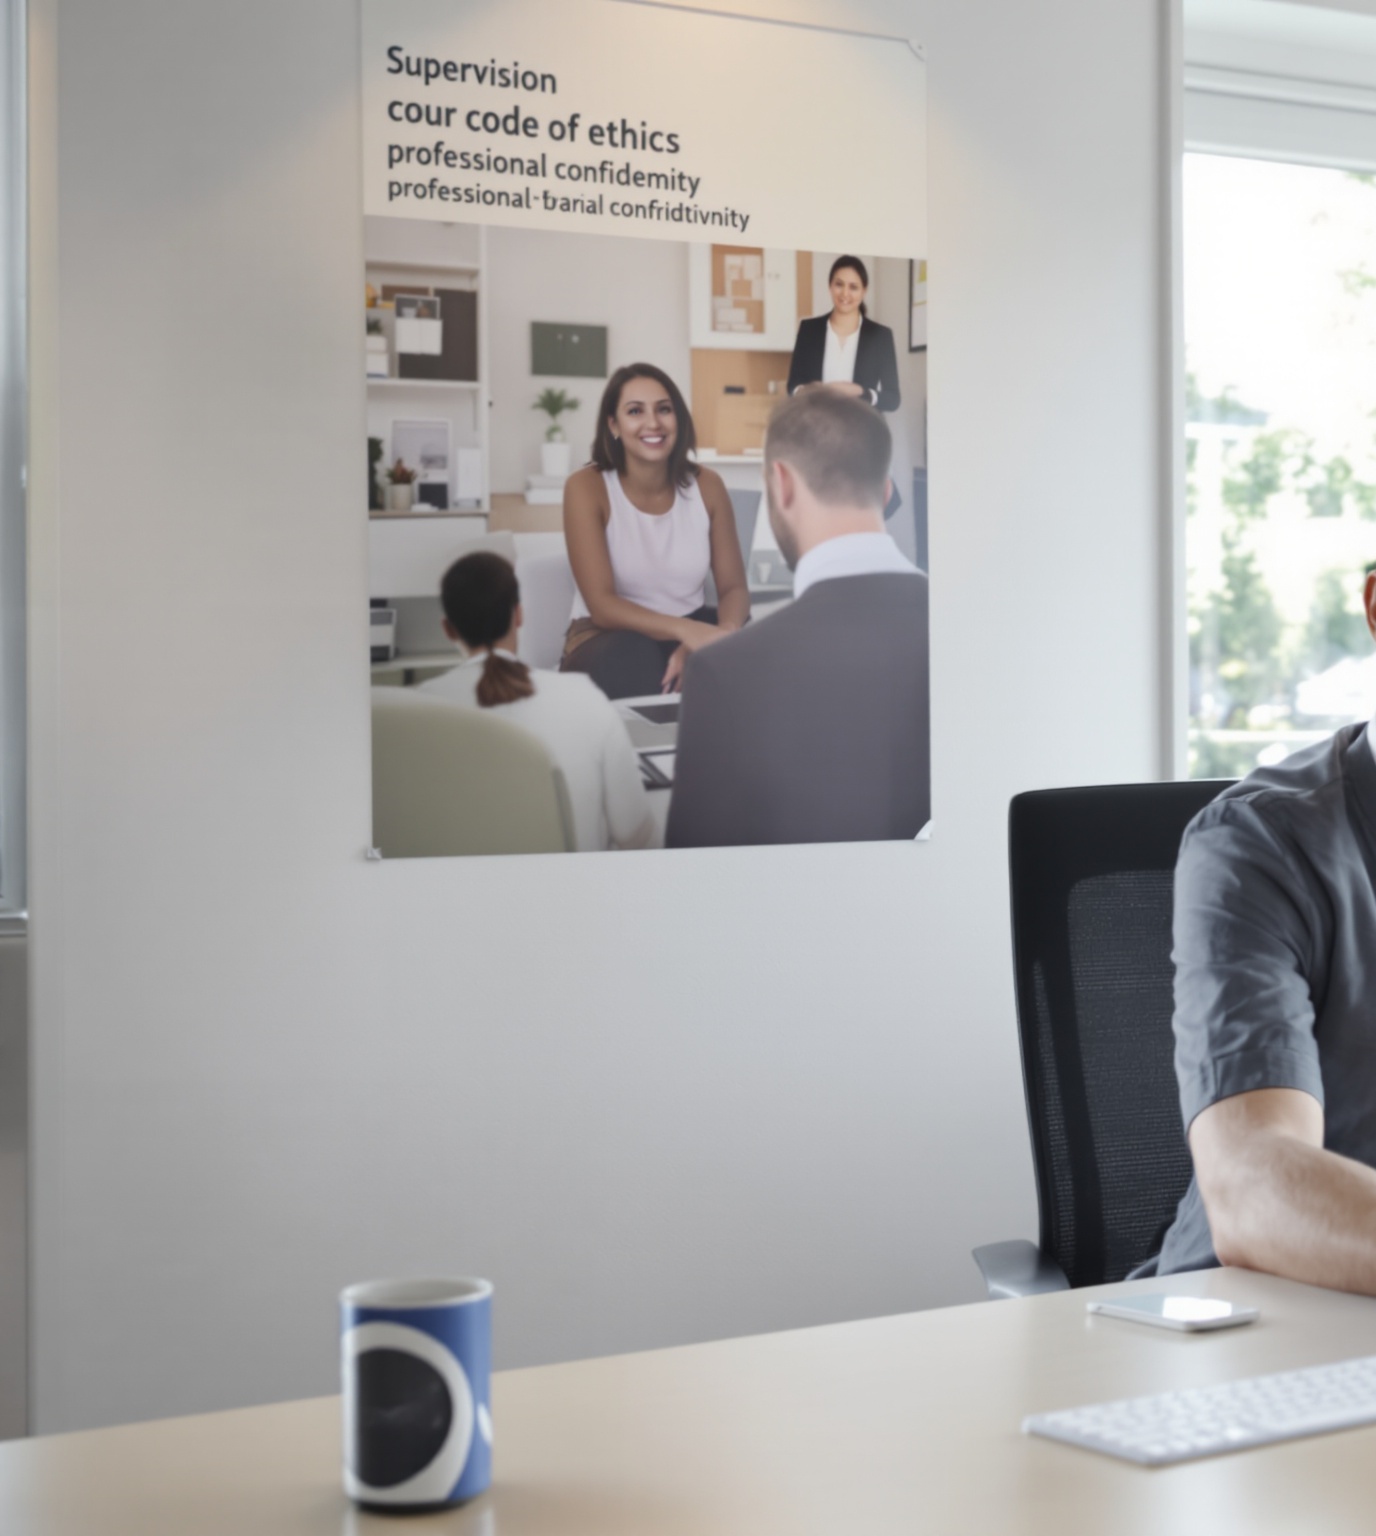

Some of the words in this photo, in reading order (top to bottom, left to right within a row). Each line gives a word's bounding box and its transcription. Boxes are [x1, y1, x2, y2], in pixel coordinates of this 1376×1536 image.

[387, 45, 557, 94] Supervision
[387, 100, 457, 127] cour
[465, 105, 539, 138] code
[548, 113, 580, 142] of
[588, 118, 680, 154] ethics
[387, 141, 547, 179] professional
[555, 160, 701, 199] confidemity
